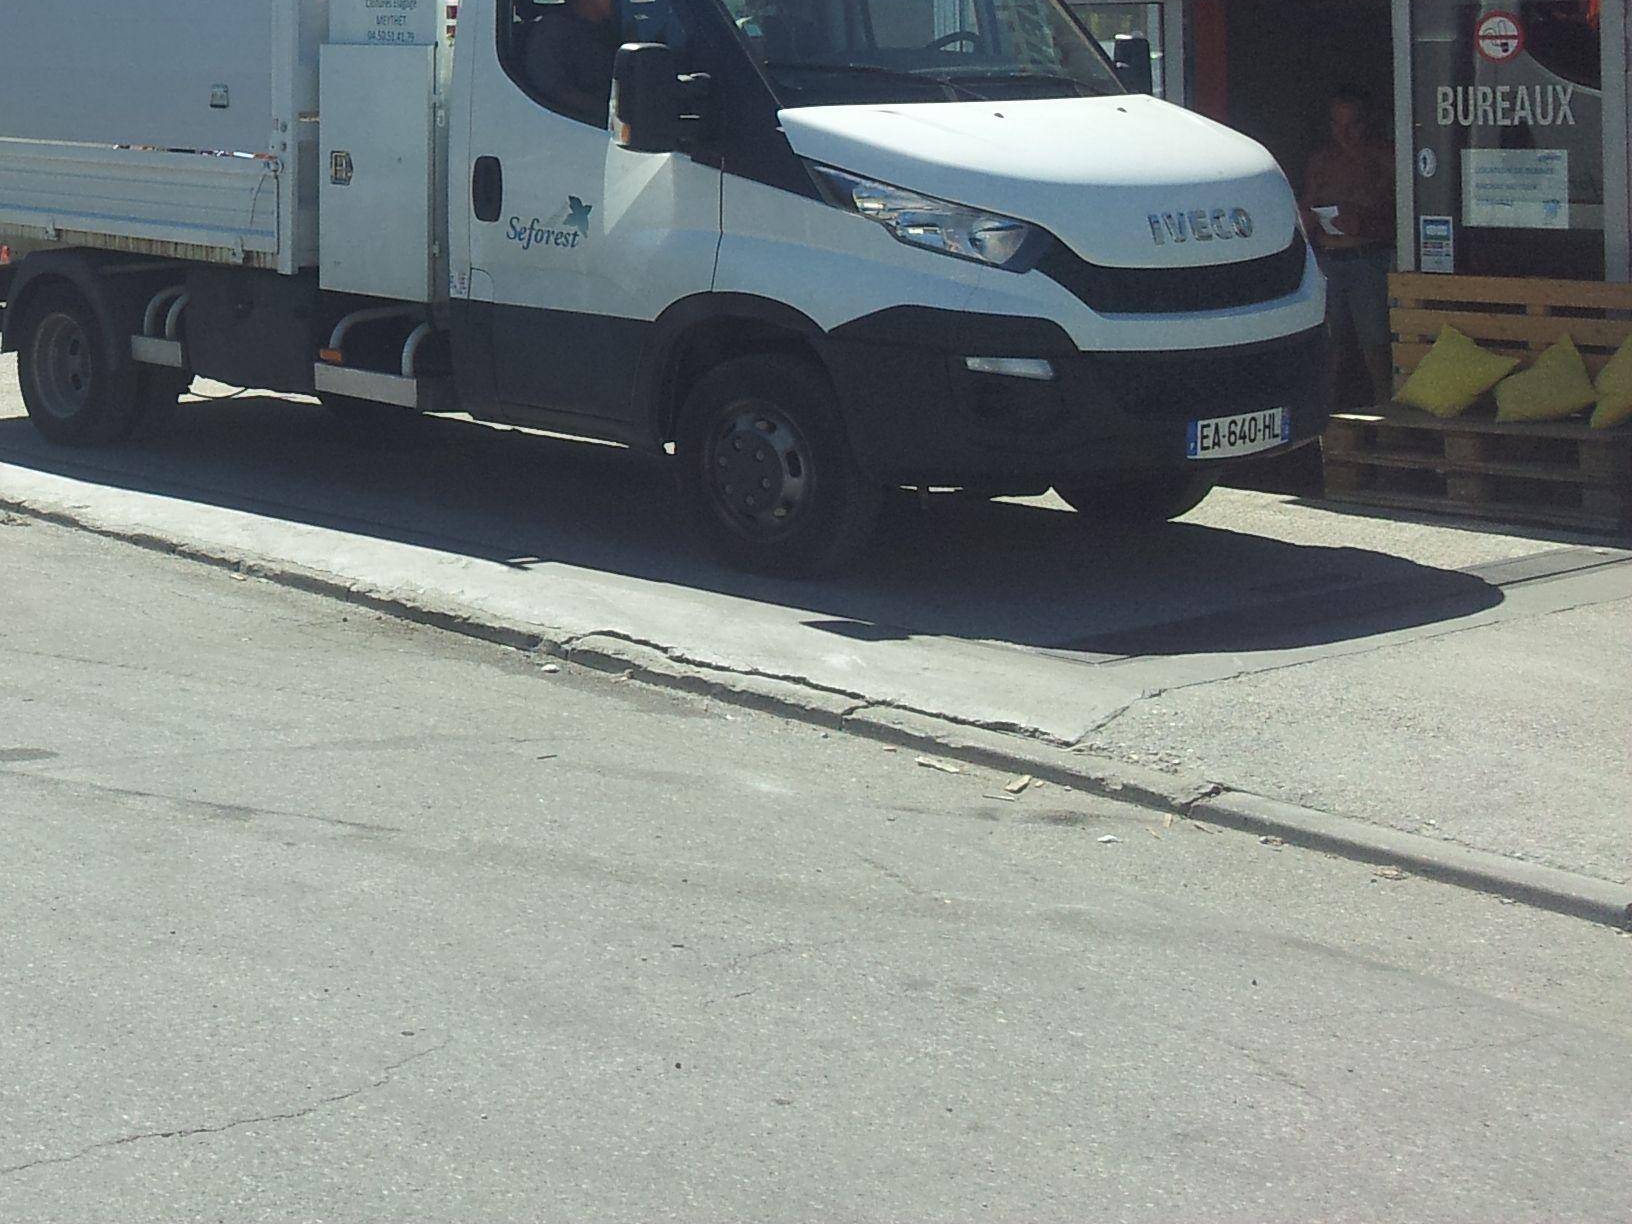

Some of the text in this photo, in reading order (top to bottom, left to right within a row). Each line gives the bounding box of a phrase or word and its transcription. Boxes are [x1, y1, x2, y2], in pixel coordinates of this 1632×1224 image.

[376, 15, 406, 26] MEYTHET
[1437, 85, 1575, 126] BUREAUX
[506, 216, 579, 250] Seforest
[1146, 207, 1253, 247] IVECO
[1200, 412, 1280, 452] EA-640-HL
